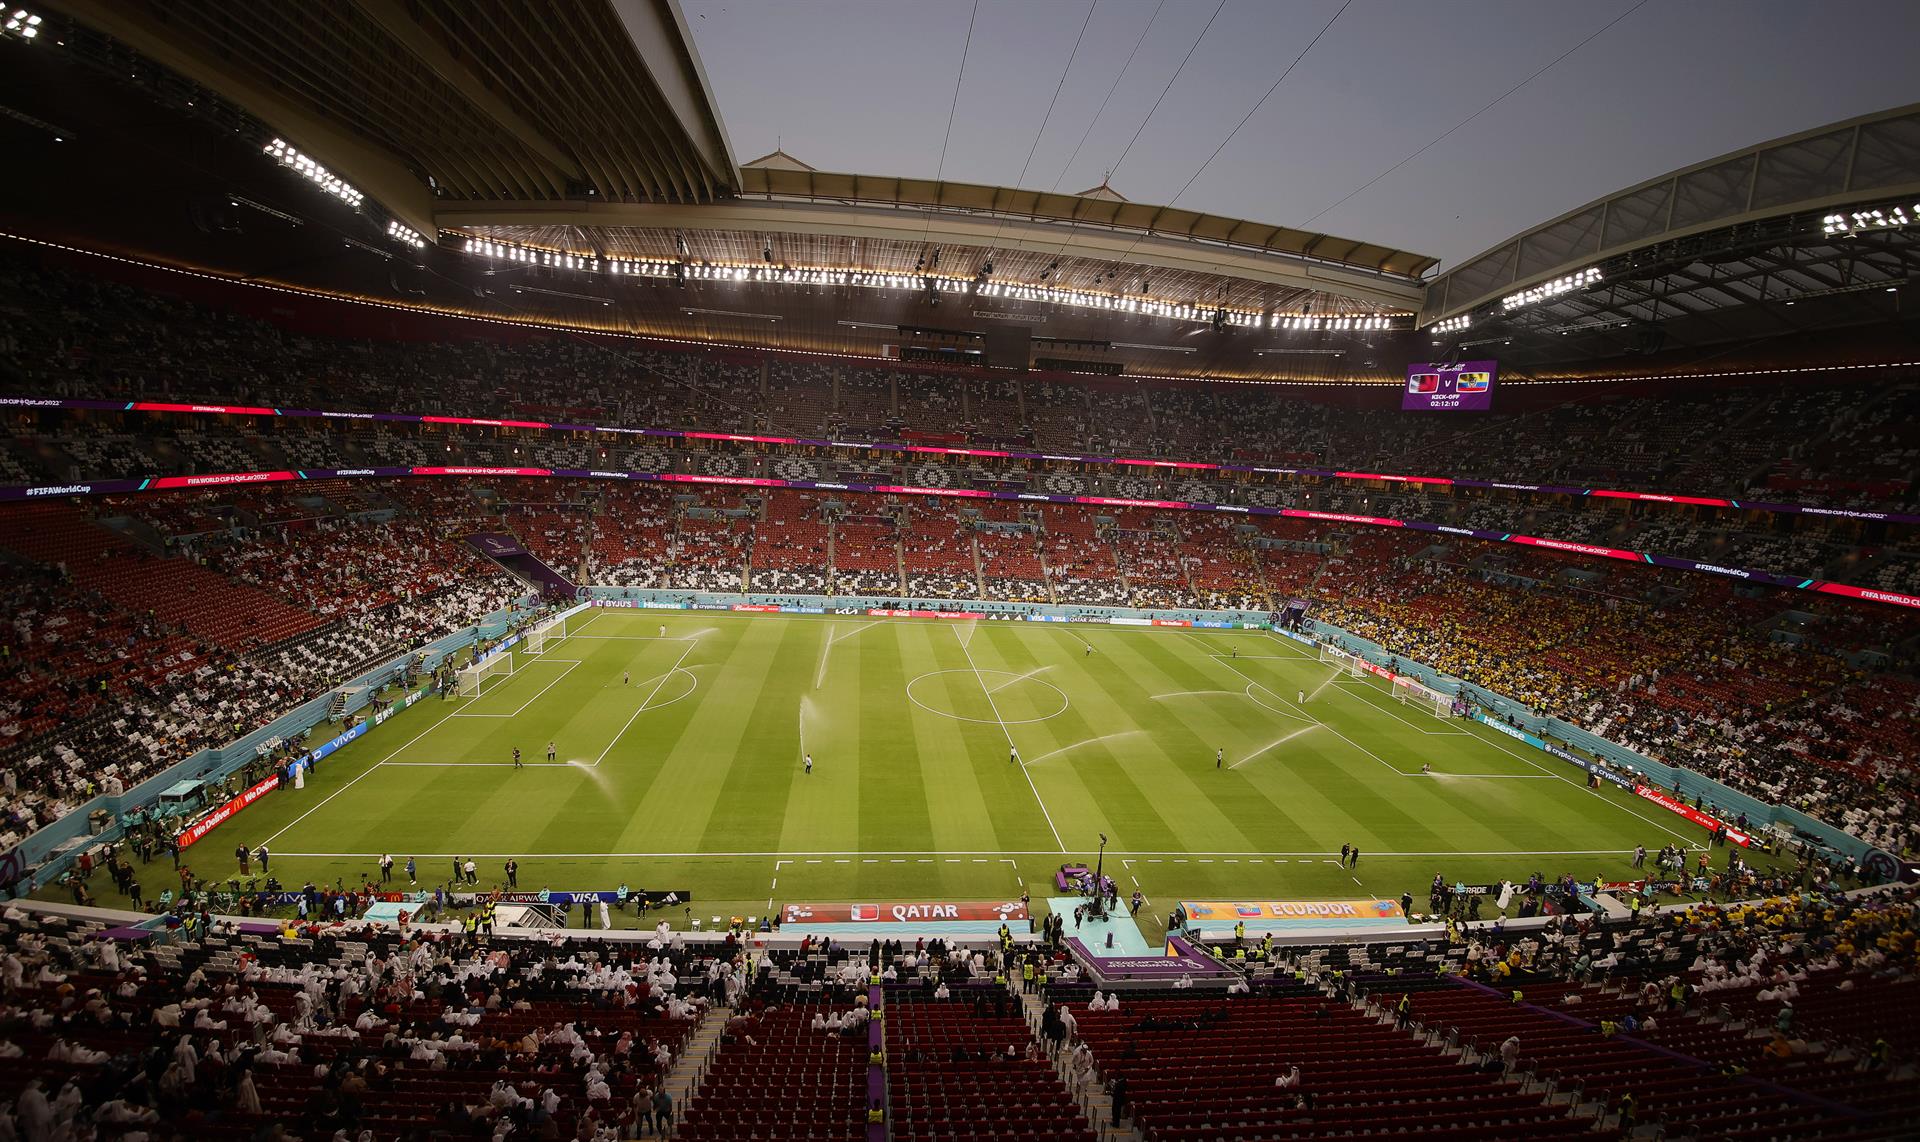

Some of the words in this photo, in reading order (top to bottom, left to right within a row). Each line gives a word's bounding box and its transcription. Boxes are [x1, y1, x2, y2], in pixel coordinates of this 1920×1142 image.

[1444, 380, 1452, 388] V
[26, 485, 91, 496] #FIFAWorldCup
[1695, 563, 1750, 578] #FIFAWorldCup
[1861, 590, 1879, 599] FIFA
[1879, 592, 1910, 604] WORLD
[606, 600, 632, 608] BYJU'S
[643, 601, 681, 609] Hisense
[1483, 716, 1526, 740] Hisense
[332, 730, 356, 748] vivo
[1552, 747, 1585, 766] crypto.com
[244, 791, 256, 803] We
[1638, 784, 1687, 816] Budweiser
[193, 825, 206, 838] We
[206, 809, 231, 830] Deliver
[1695, 816, 1714, 828] ZERO
[570, 893, 600, 903] VISA
[892, 904, 958, 922] QATAR
[1270, 903, 1355, 915] ECUADOR
